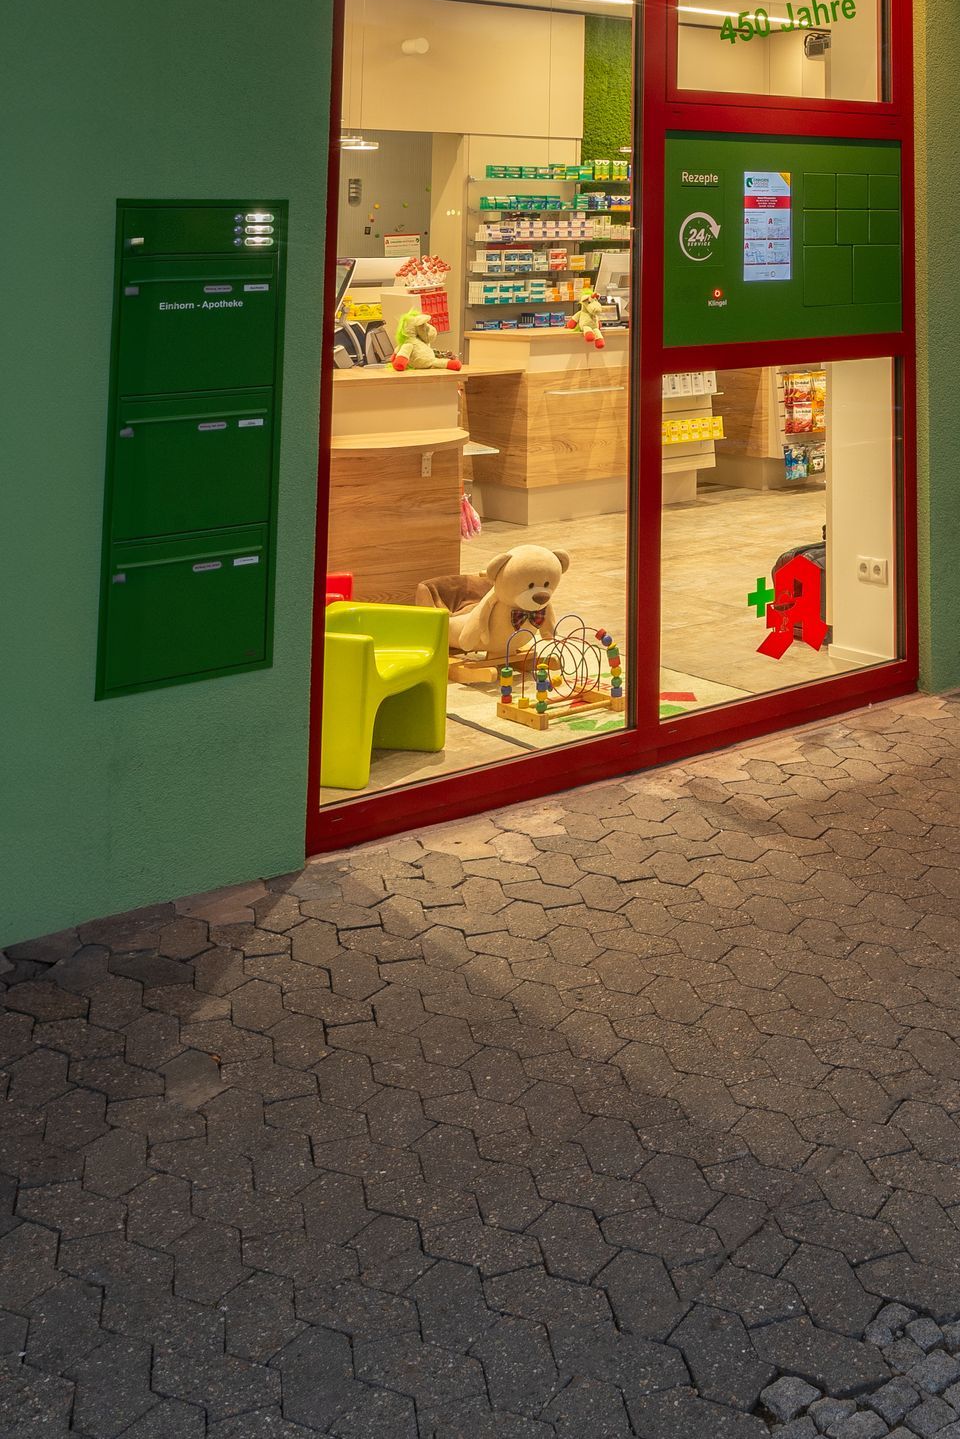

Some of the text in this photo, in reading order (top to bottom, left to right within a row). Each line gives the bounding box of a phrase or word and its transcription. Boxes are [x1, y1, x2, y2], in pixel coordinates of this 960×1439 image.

[720, 8, 771, 45] 450
[681, 171, 719, 186] Rezepte
[687, 228, 712, 243] 24/7
[159, 301, 195, 310] Einhorn
[202, 299, 244, 310] Apotheke
[707, 299, 728, 308] Klingel
